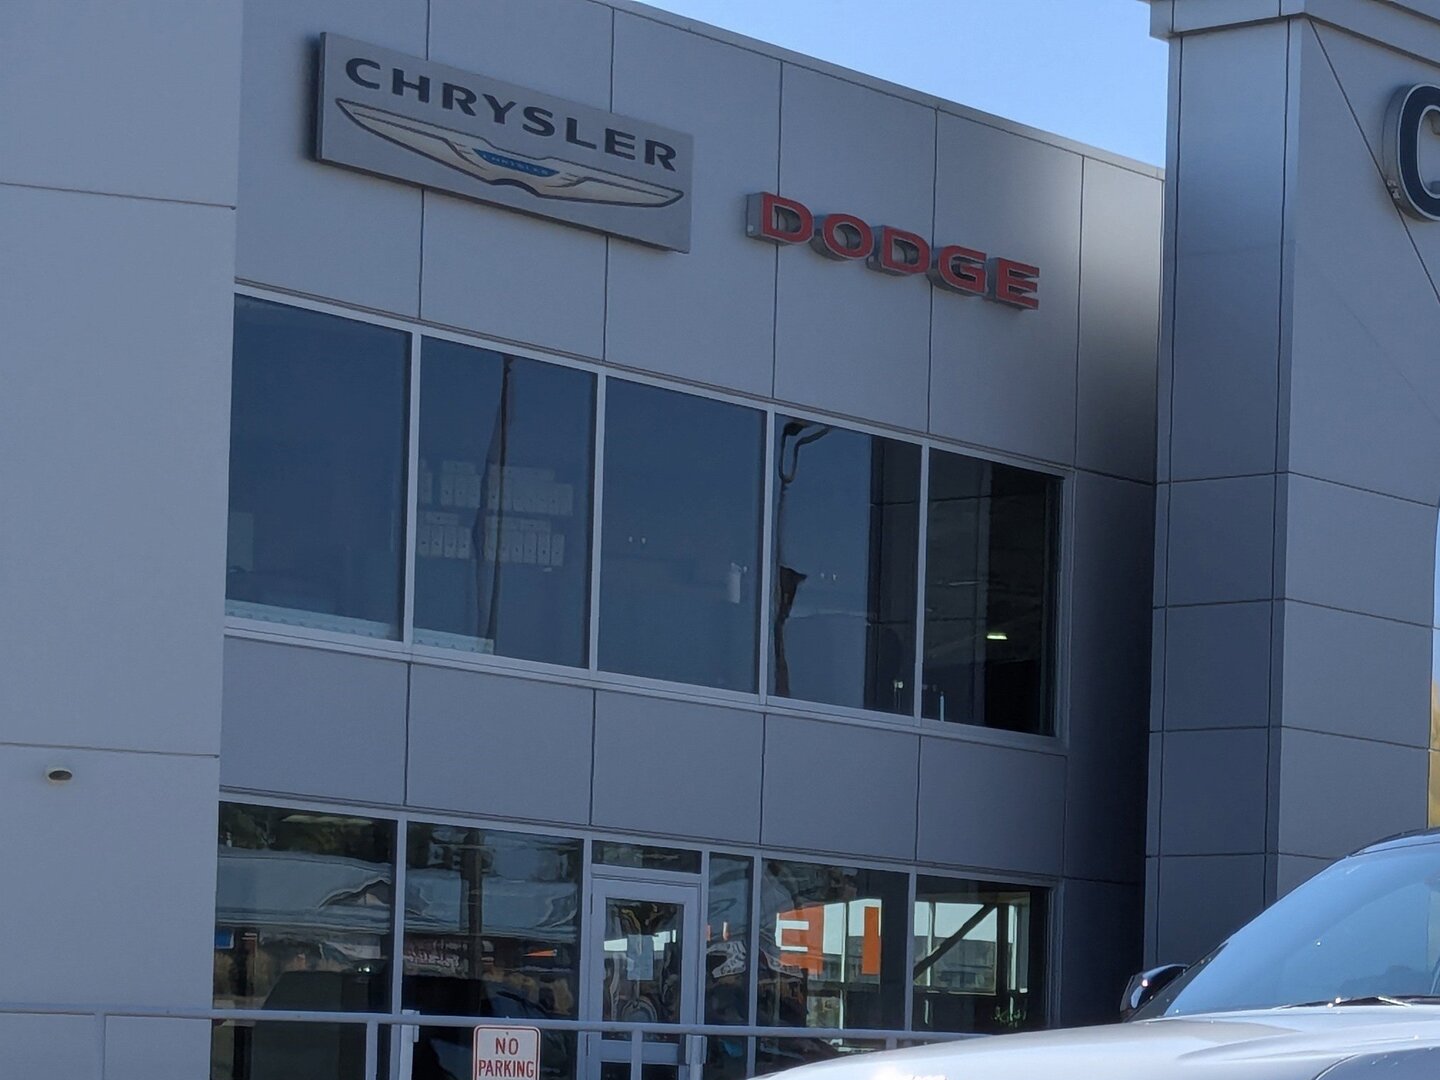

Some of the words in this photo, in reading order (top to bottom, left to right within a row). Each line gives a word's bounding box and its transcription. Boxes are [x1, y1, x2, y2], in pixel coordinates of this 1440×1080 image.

[345, 57, 678, 172] CHRYSLER
[747, 191, 1040, 312] DODGE
[478, 1059, 535, 1078] PARKING
[495, 1037, 519, 1055] NO
